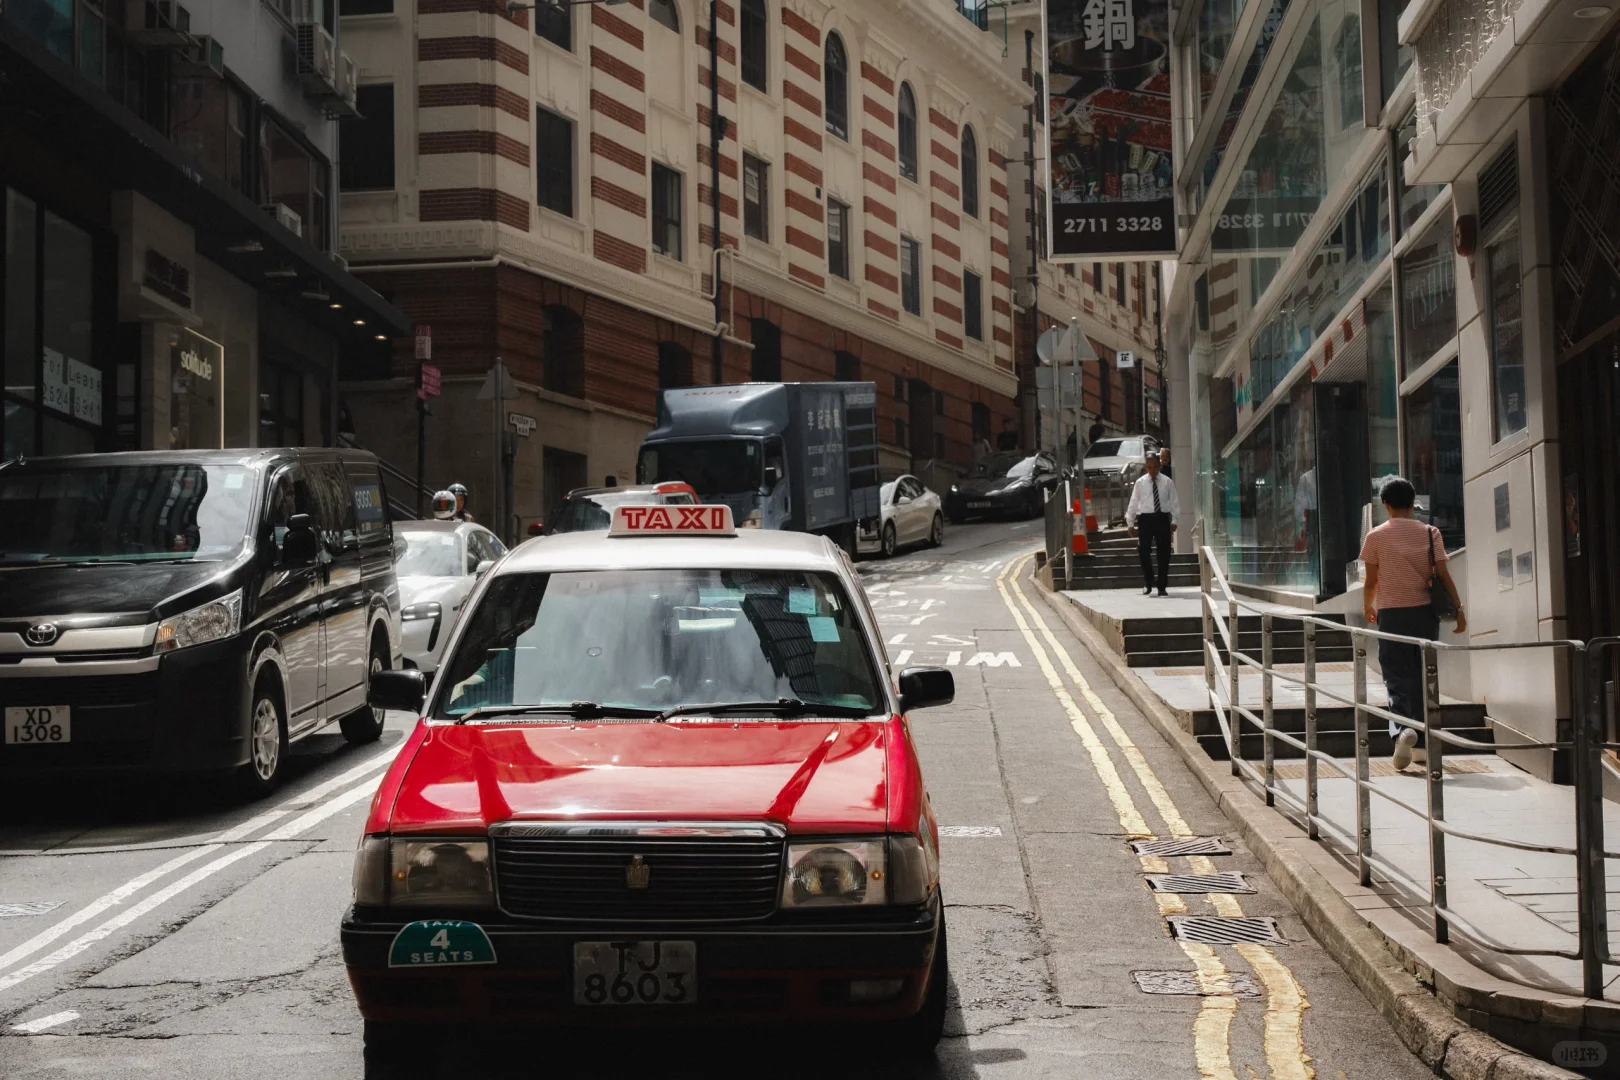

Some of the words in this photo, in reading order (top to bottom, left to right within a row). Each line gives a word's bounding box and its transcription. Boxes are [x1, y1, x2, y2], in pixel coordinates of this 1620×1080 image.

[1082, 0, 1135, 50] 鍋
[1064, 218, 1107, 233] 2711
[1116, 216, 1162, 232] 3328
[181, 349, 212, 380] solitude
[69, 365, 101, 392] Lease
[622, 508, 724, 529] TAXI
[25, 707, 52, 725] XD
[14, 725, 62, 743] 1308
[430, 929, 450, 950] 4
[410, 951, 474, 963] SEATS
[610, 942, 660, 971] TJ
[584, 972, 687, 1003] 8603
